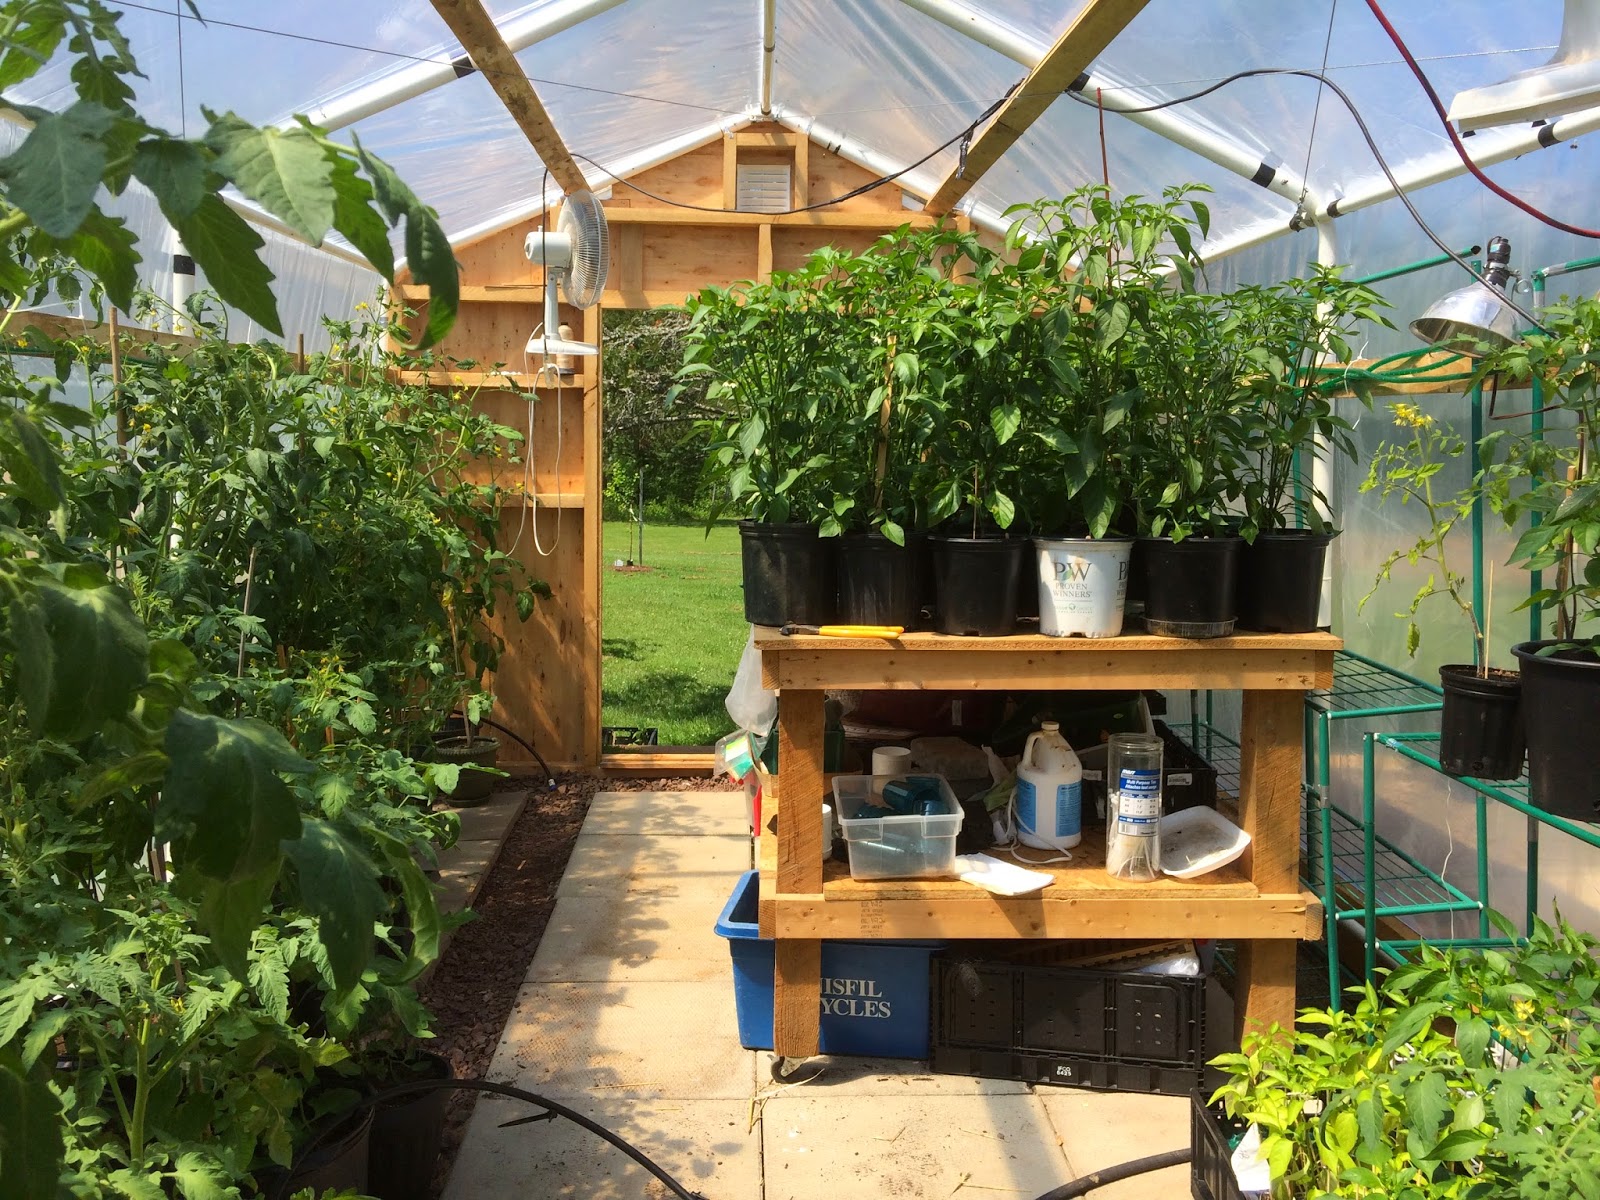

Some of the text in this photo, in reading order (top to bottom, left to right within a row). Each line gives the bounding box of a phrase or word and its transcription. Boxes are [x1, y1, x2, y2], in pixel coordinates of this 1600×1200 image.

[1052, 561, 1092, 581] PW
[1055, 582, 1088, 590] PROVEN
[1053, 590, 1091, 598] WINNERS
[820, 978, 882, 998] ISFIL
